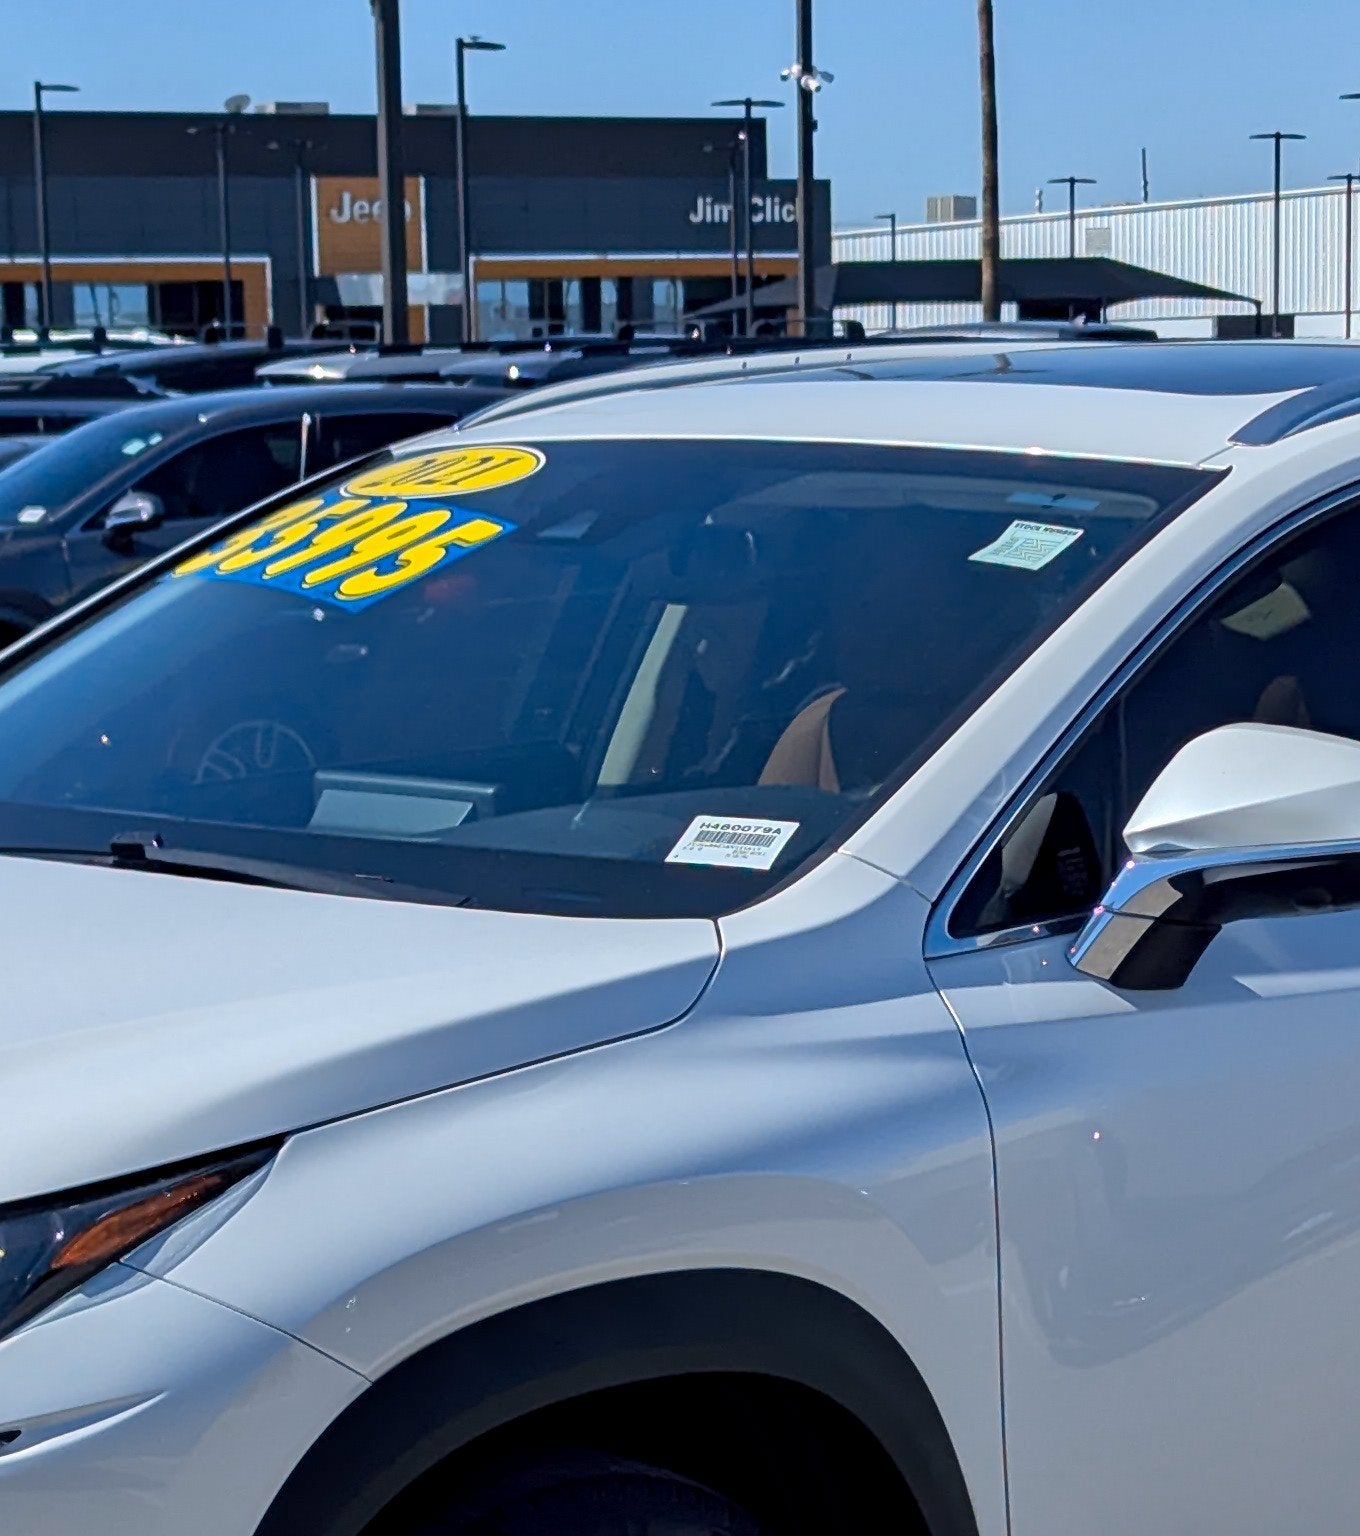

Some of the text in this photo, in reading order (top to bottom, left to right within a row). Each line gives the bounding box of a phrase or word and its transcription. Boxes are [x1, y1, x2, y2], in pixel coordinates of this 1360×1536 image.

[689, 194, 801, 223] Jim Clic
[357, 455, 526, 489] 2021
[170, 497, 505, 602] 35995
